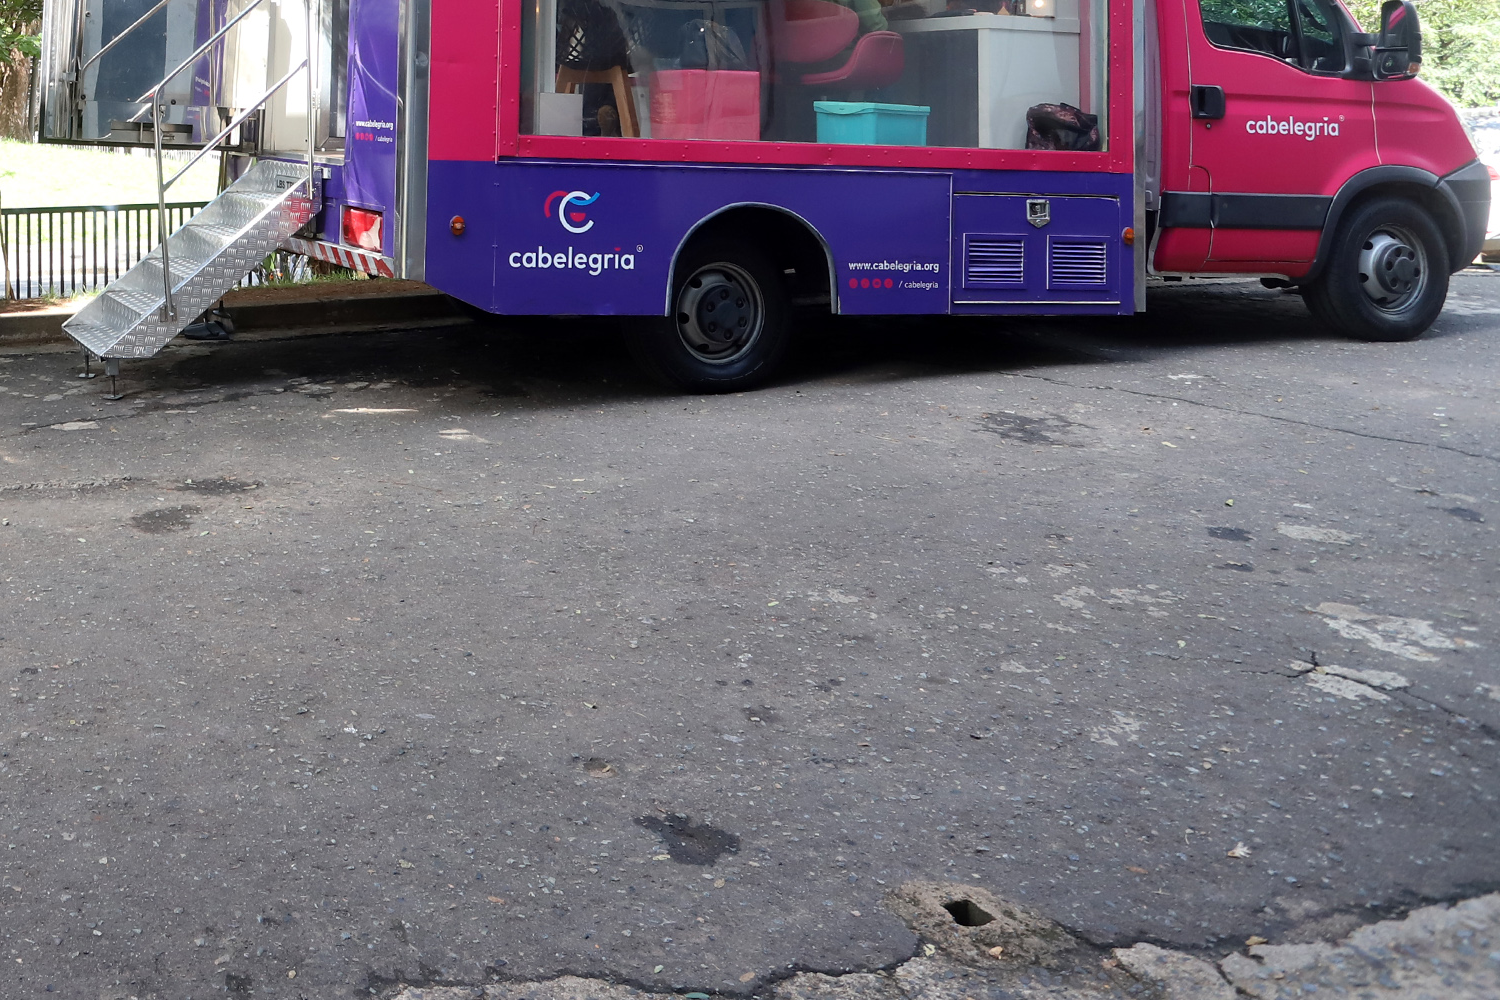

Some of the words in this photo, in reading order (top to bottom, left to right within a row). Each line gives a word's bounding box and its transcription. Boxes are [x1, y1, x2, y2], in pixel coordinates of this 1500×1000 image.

[1246, 115, 1339, 141] cabelegria
[508, 245, 635, 276] cabelegria
[848, 260, 939, 273] www.cabelegria.org
[904, 281, 939, 291] cabelegria
